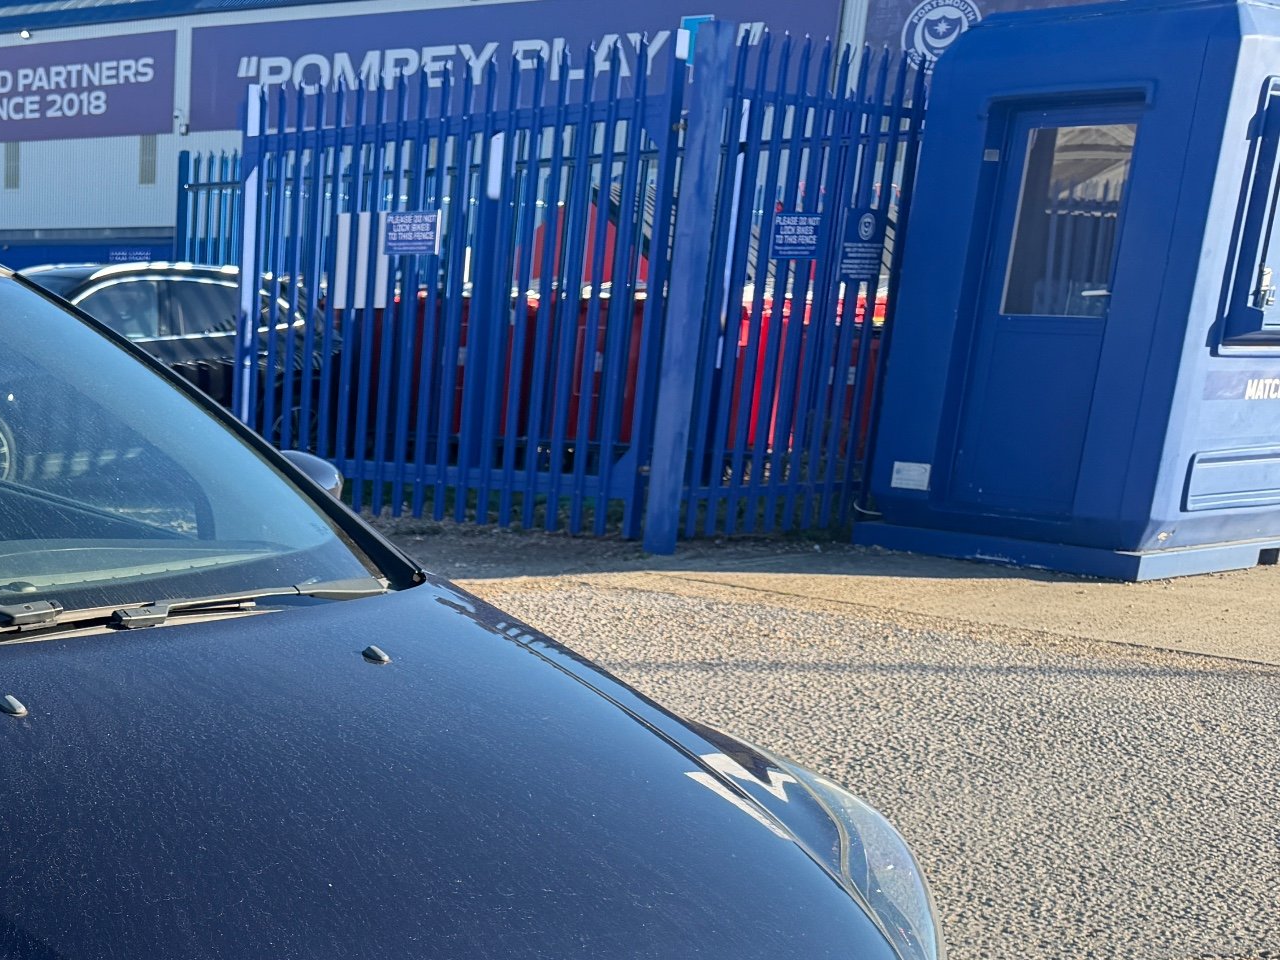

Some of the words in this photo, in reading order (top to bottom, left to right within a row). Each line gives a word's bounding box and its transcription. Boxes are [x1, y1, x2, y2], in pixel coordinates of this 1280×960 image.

[19, 57, 155, 92] PARTNERS
[45, 91, 107, 118] 2018
[387, 215, 413, 224] PLEASE
[423, 214, 436, 222] NOT
[775, 216, 798, 225] PLEASE
[808, 217, 821, 225] NOT
[393, 224, 410, 233] LOCK
[780, 226, 795, 234] LOCK
[388, 232, 397, 241] TO
[398, 232, 413, 241] THIS
[414, 232, 434, 240] FENCE
[775, 235, 784, 244] TO
[784, 235, 797, 244] THIS
[798, 235, 817, 244] FENCE
[1245, 379, 1280, 400] MATC
